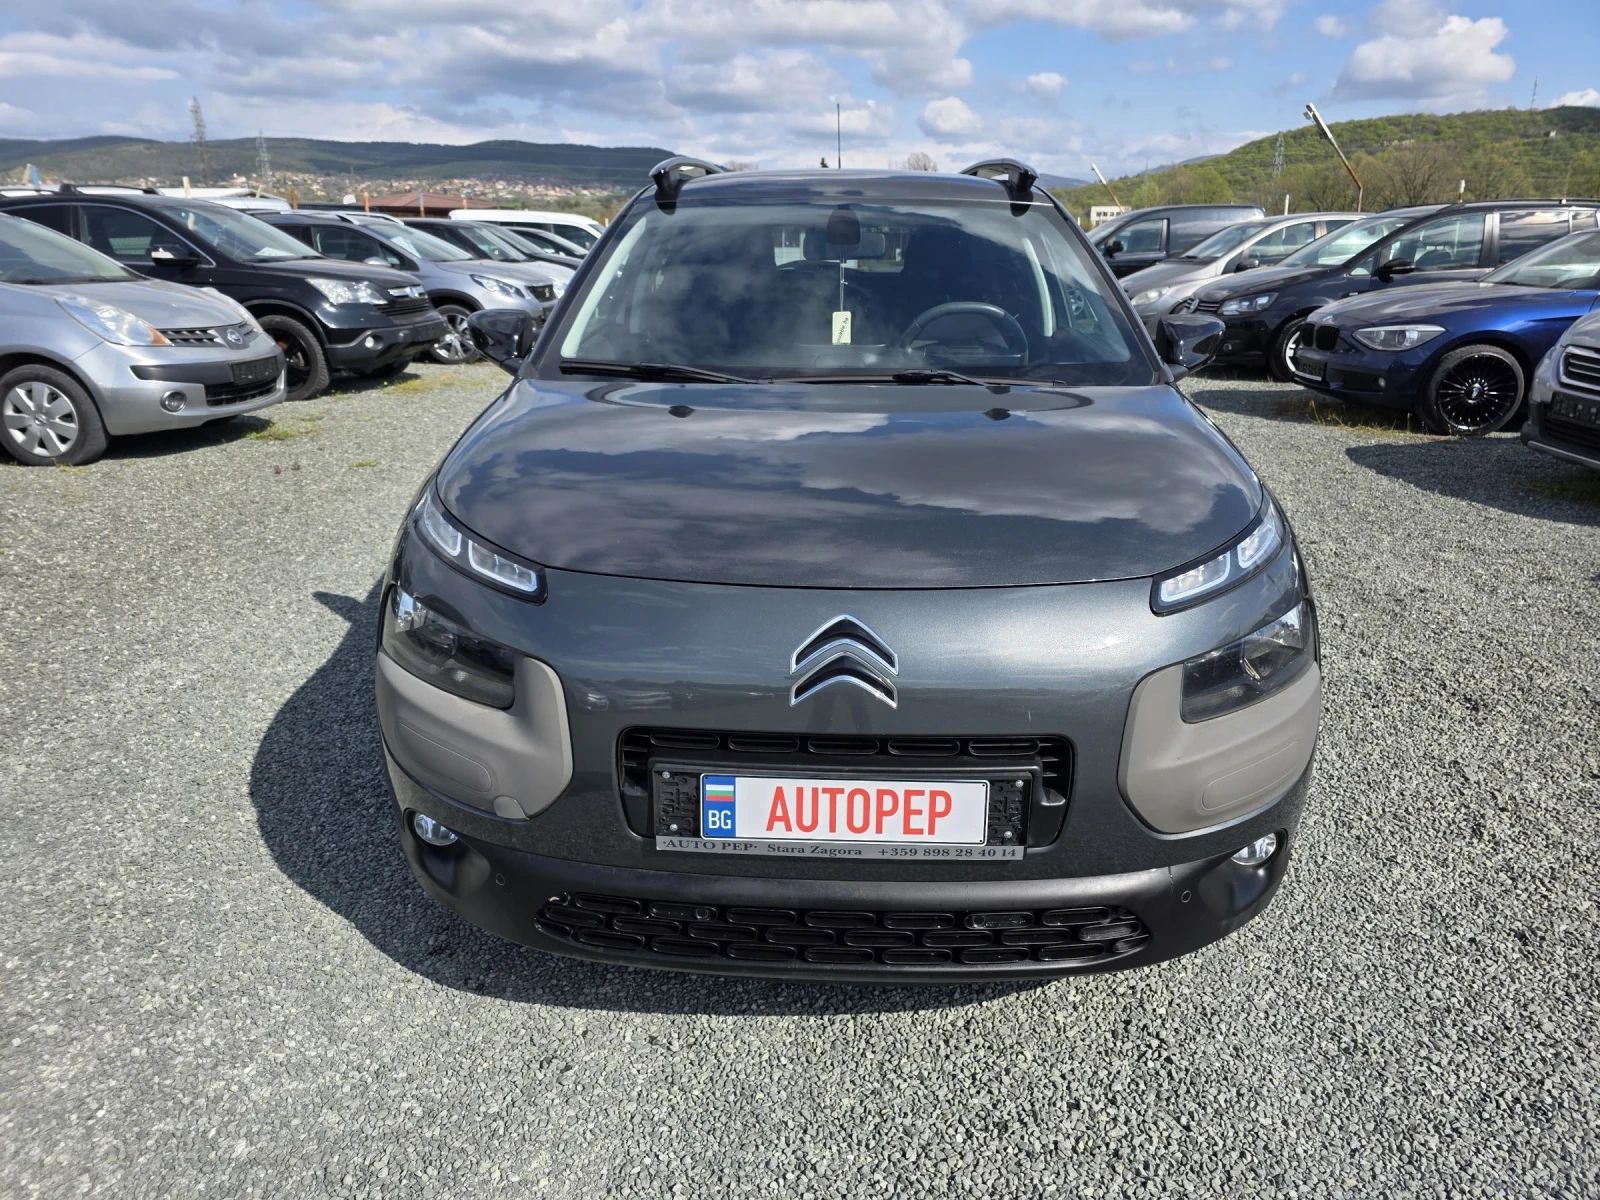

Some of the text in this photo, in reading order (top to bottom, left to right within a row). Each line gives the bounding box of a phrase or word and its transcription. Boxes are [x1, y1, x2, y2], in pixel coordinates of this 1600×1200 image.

[708, 810, 732, 829] BG
[766, 786, 952, 835] AUTOPEP
[767, 843, 805, 854] Stara
[810, 845, 863, 857] Zagora
[878, 847, 918, 857] +359
[922, 848, 950, 857] 898
[955, 848, 973, 857] 28
[977, 848, 996, 857] 40
[1001, 848, 1016, 857] 14
